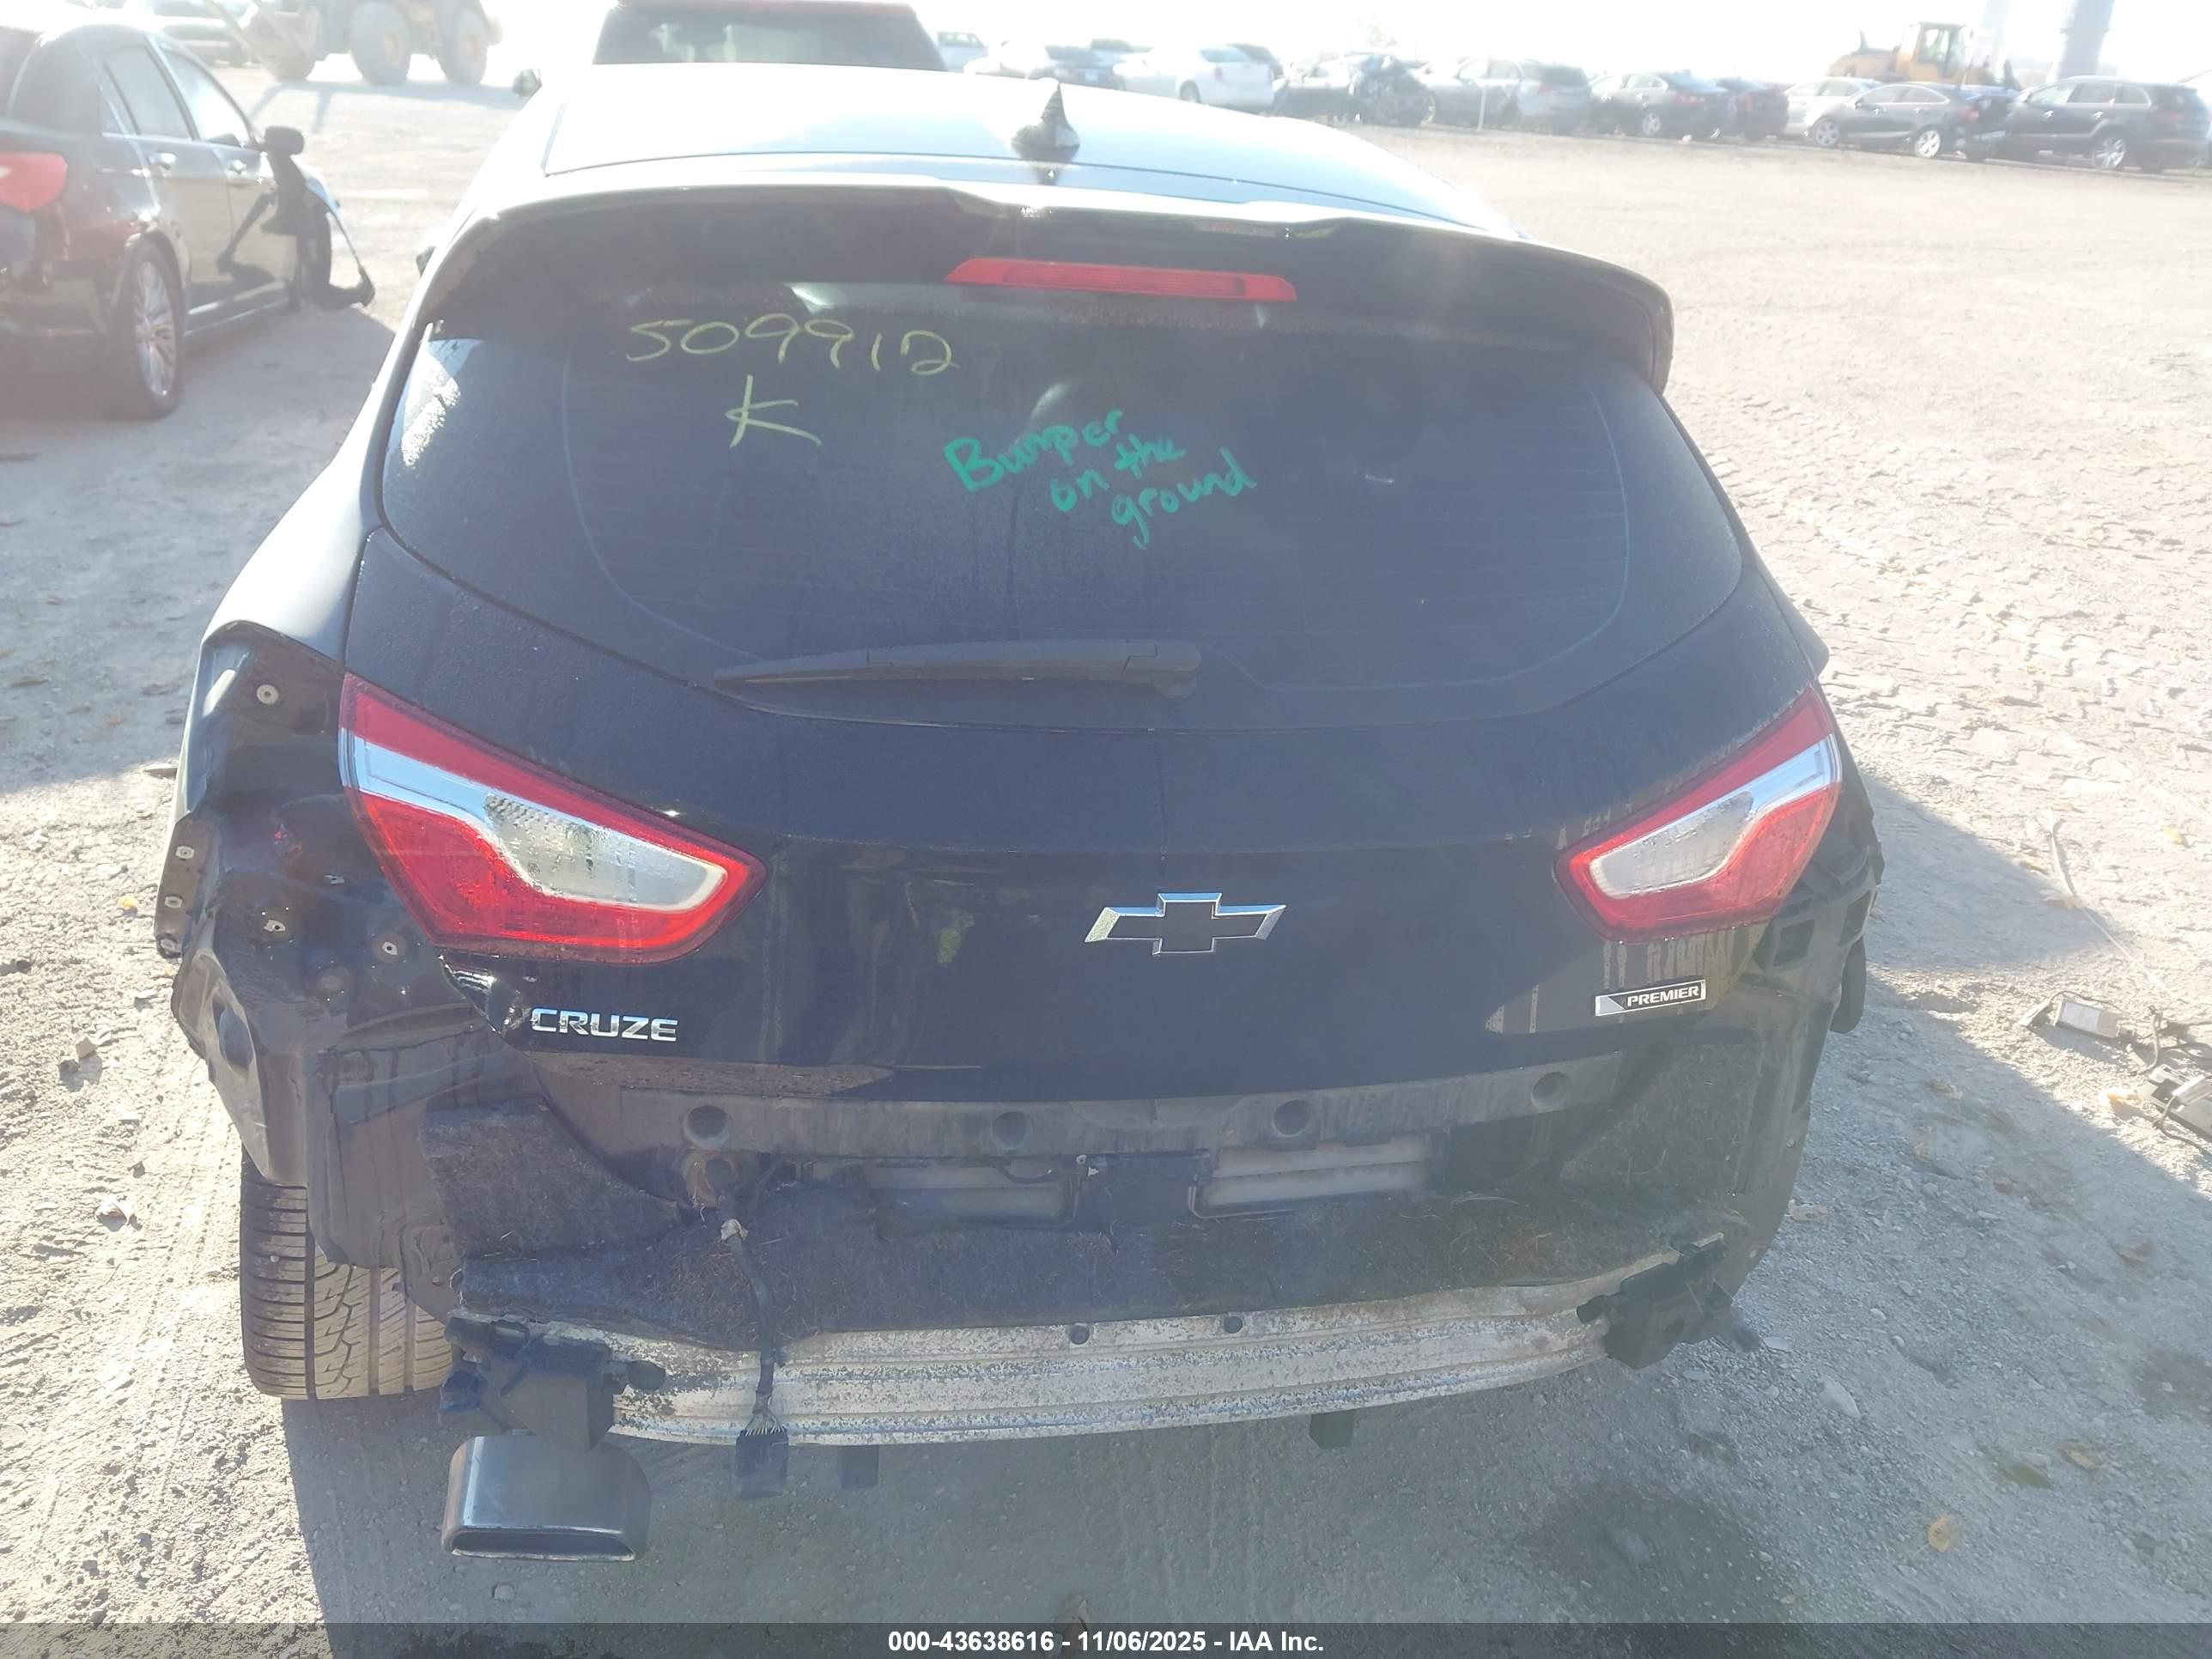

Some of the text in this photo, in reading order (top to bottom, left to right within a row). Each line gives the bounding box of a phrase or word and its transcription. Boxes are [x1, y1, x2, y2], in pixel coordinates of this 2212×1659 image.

[626, 313, 959, 375] 509912
[725, 374, 823, 448] K
[944, 410, 1122, 494] Bumper
[1049, 434, 1187, 513] on the
[1110, 447, 1257, 550] ground
[530, 1008, 678, 1042] CRUZE
[1627, 985, 1699, 1007] PREMIER
